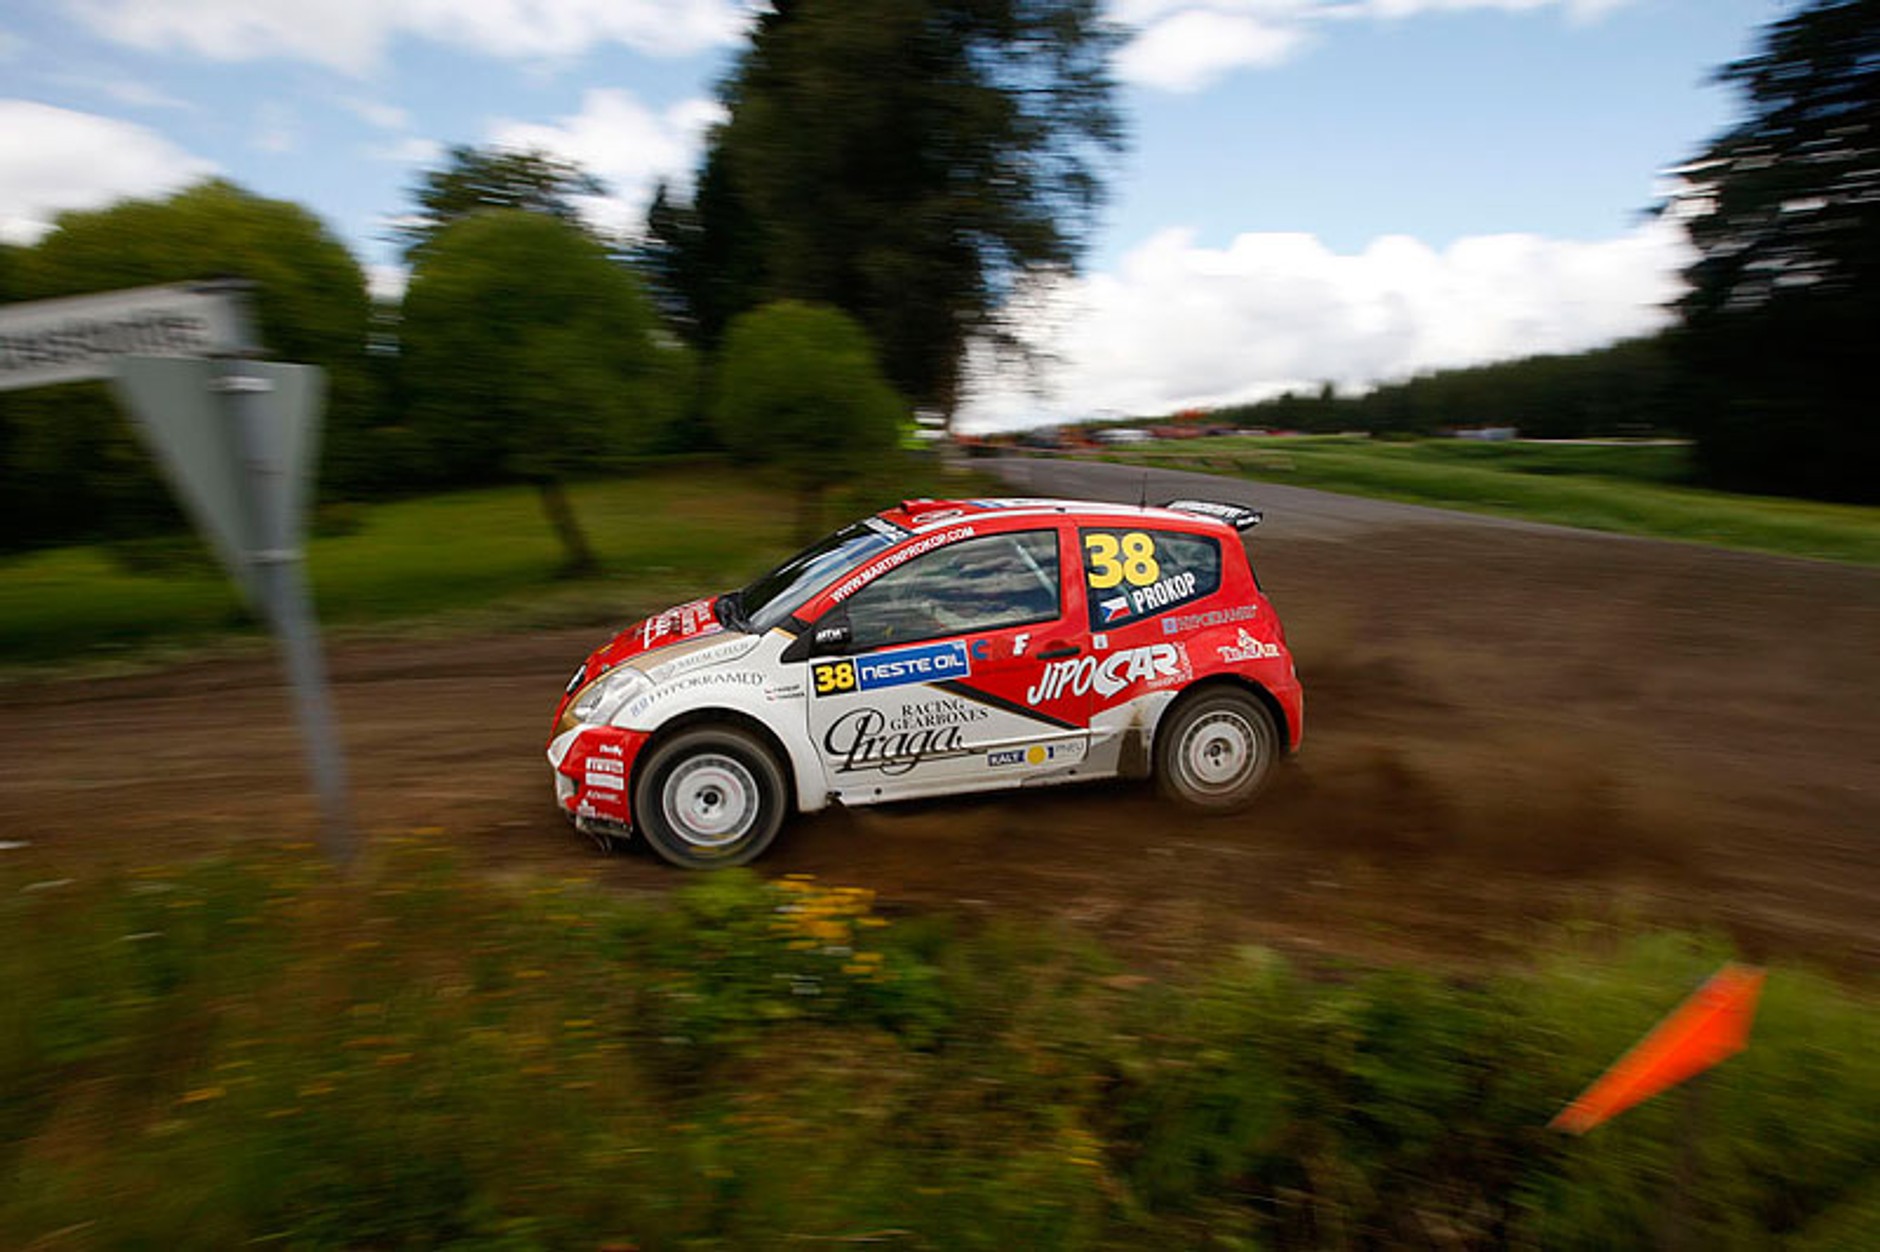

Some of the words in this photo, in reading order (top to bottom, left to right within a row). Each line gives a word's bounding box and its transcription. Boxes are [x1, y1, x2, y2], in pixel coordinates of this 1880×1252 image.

[830, 526, 975, 603] WWW.MARTINPROKOP.COM
[1085, 533, 1160, 589] 38
[1132, 571, 1196, 613] PROKOP
[815, 663, 855, 693] 38
[861, 657, 932, 681] NESTE
[934, 653, 965, 671] OIL
[890, 707, 989, 732] GEARBOXES
[902, 698, 965, 718] RACING
[824, 707, 963, 776] Praga
